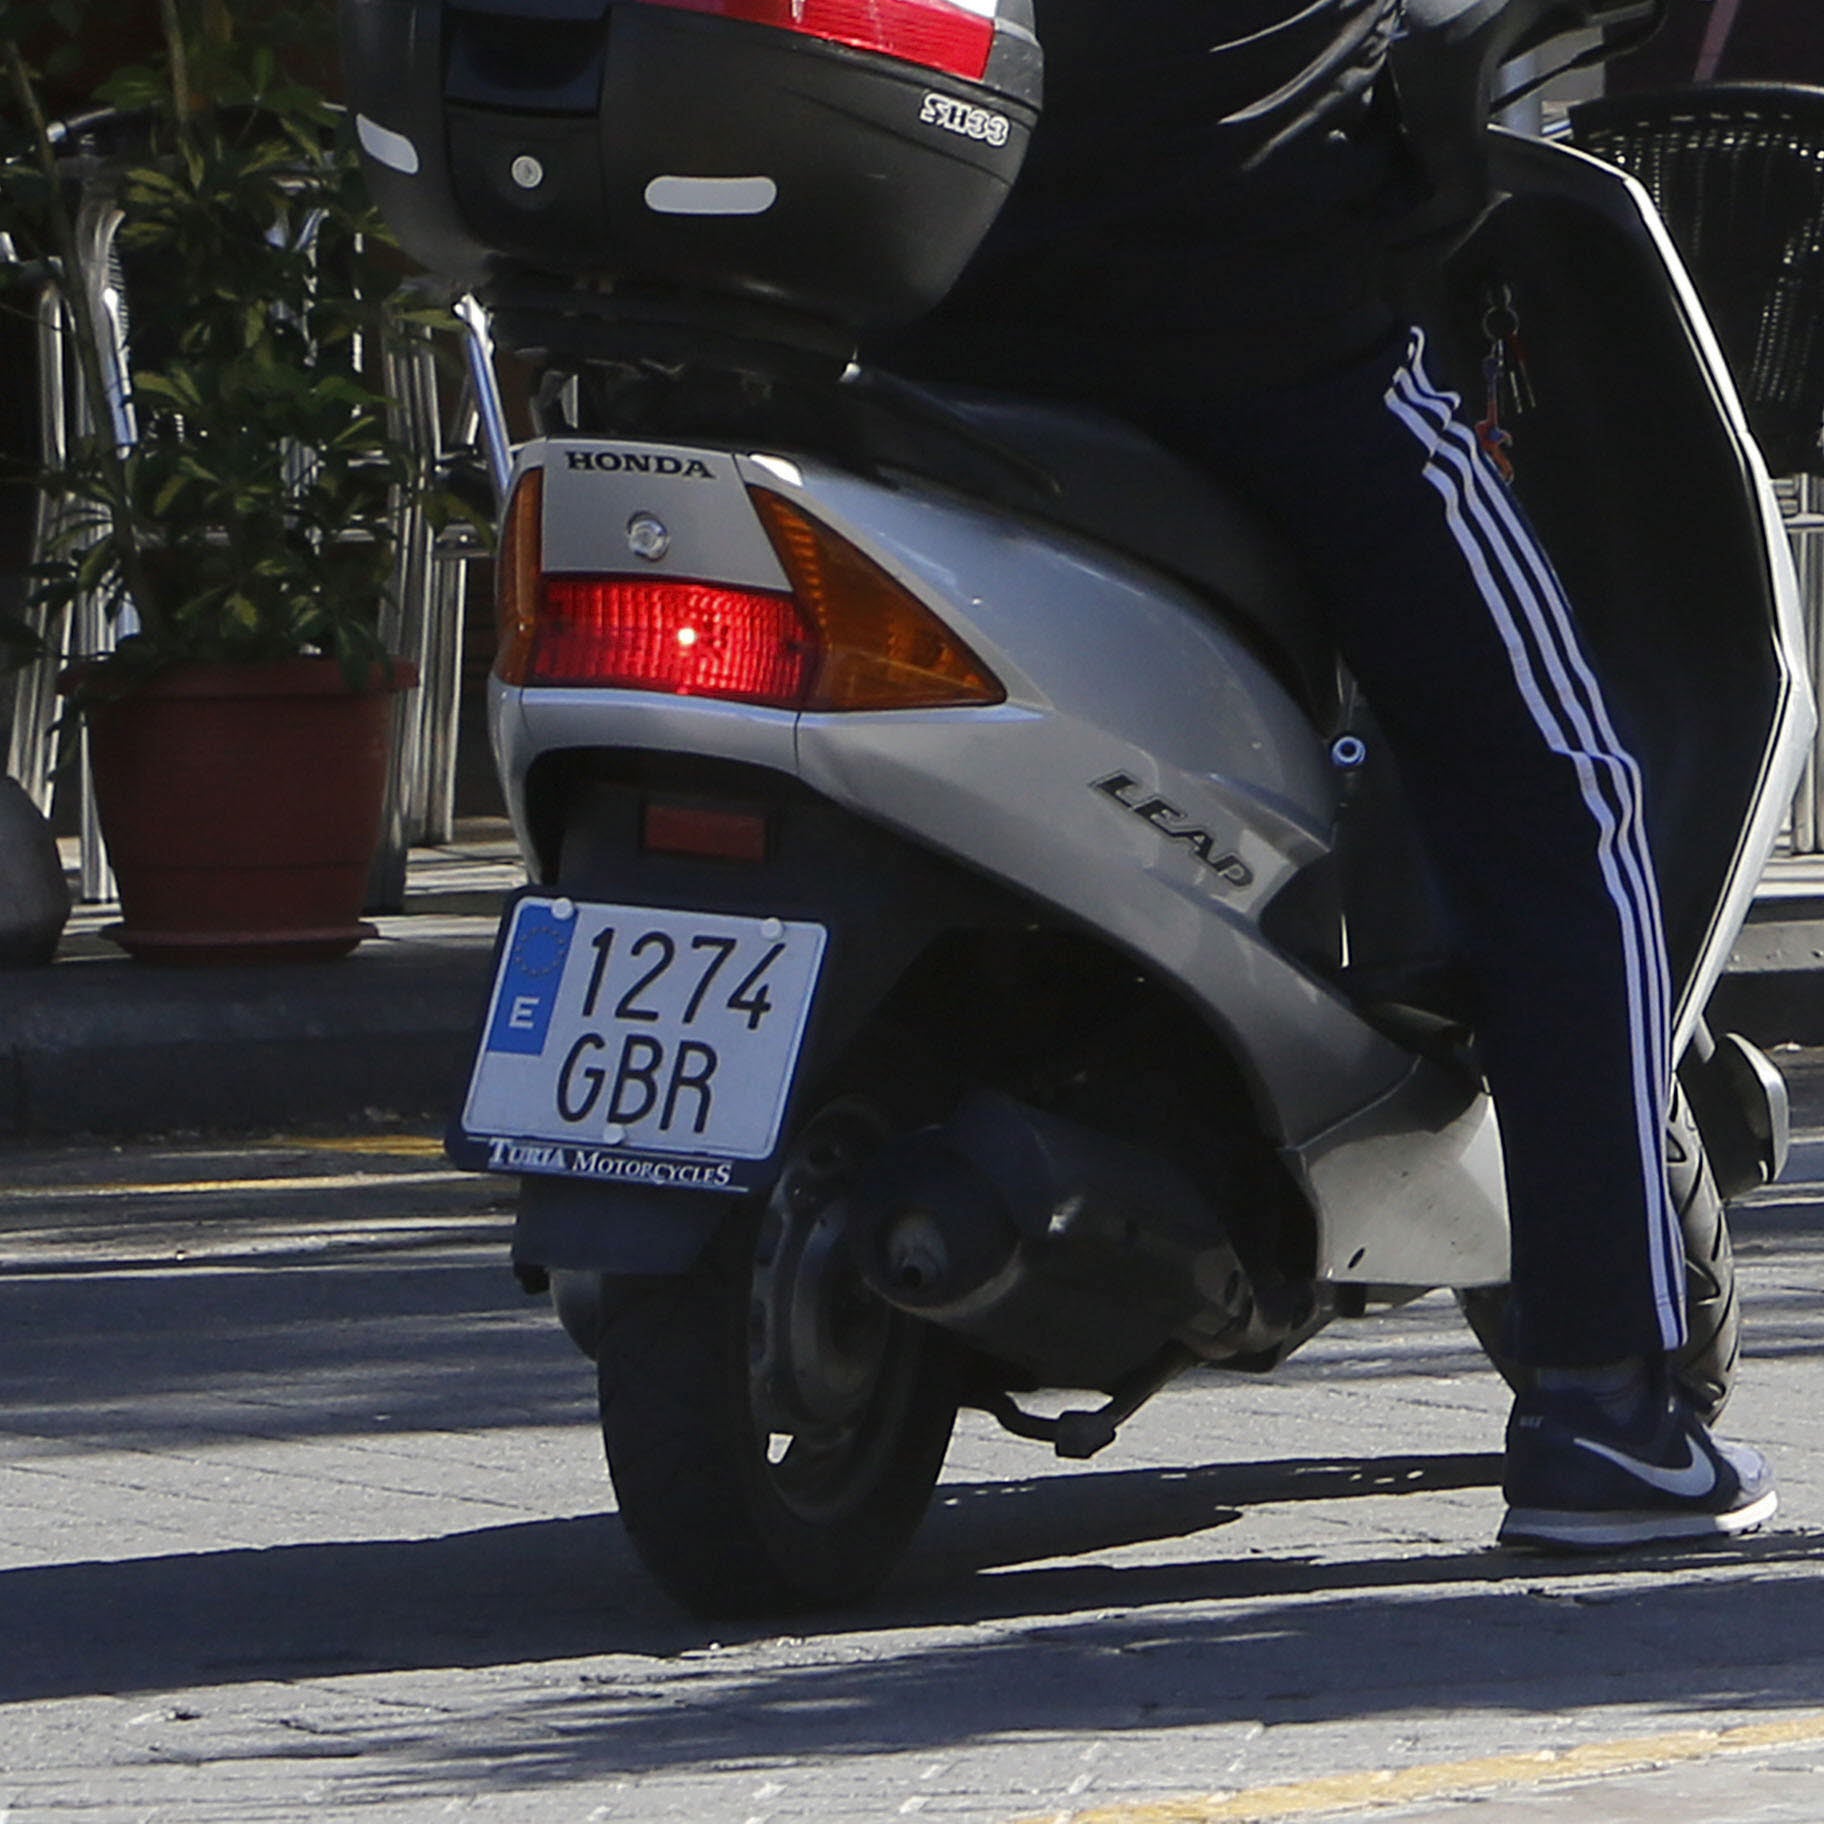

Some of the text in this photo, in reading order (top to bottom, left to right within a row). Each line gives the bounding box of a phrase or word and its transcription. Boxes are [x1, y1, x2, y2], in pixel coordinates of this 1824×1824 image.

[564, 450, 716, 480] HONDA
[508, 995, 541, 1030] E
[580, 926, 786, 1032] 1274
[556, 1032, 719, 1135] GBR
